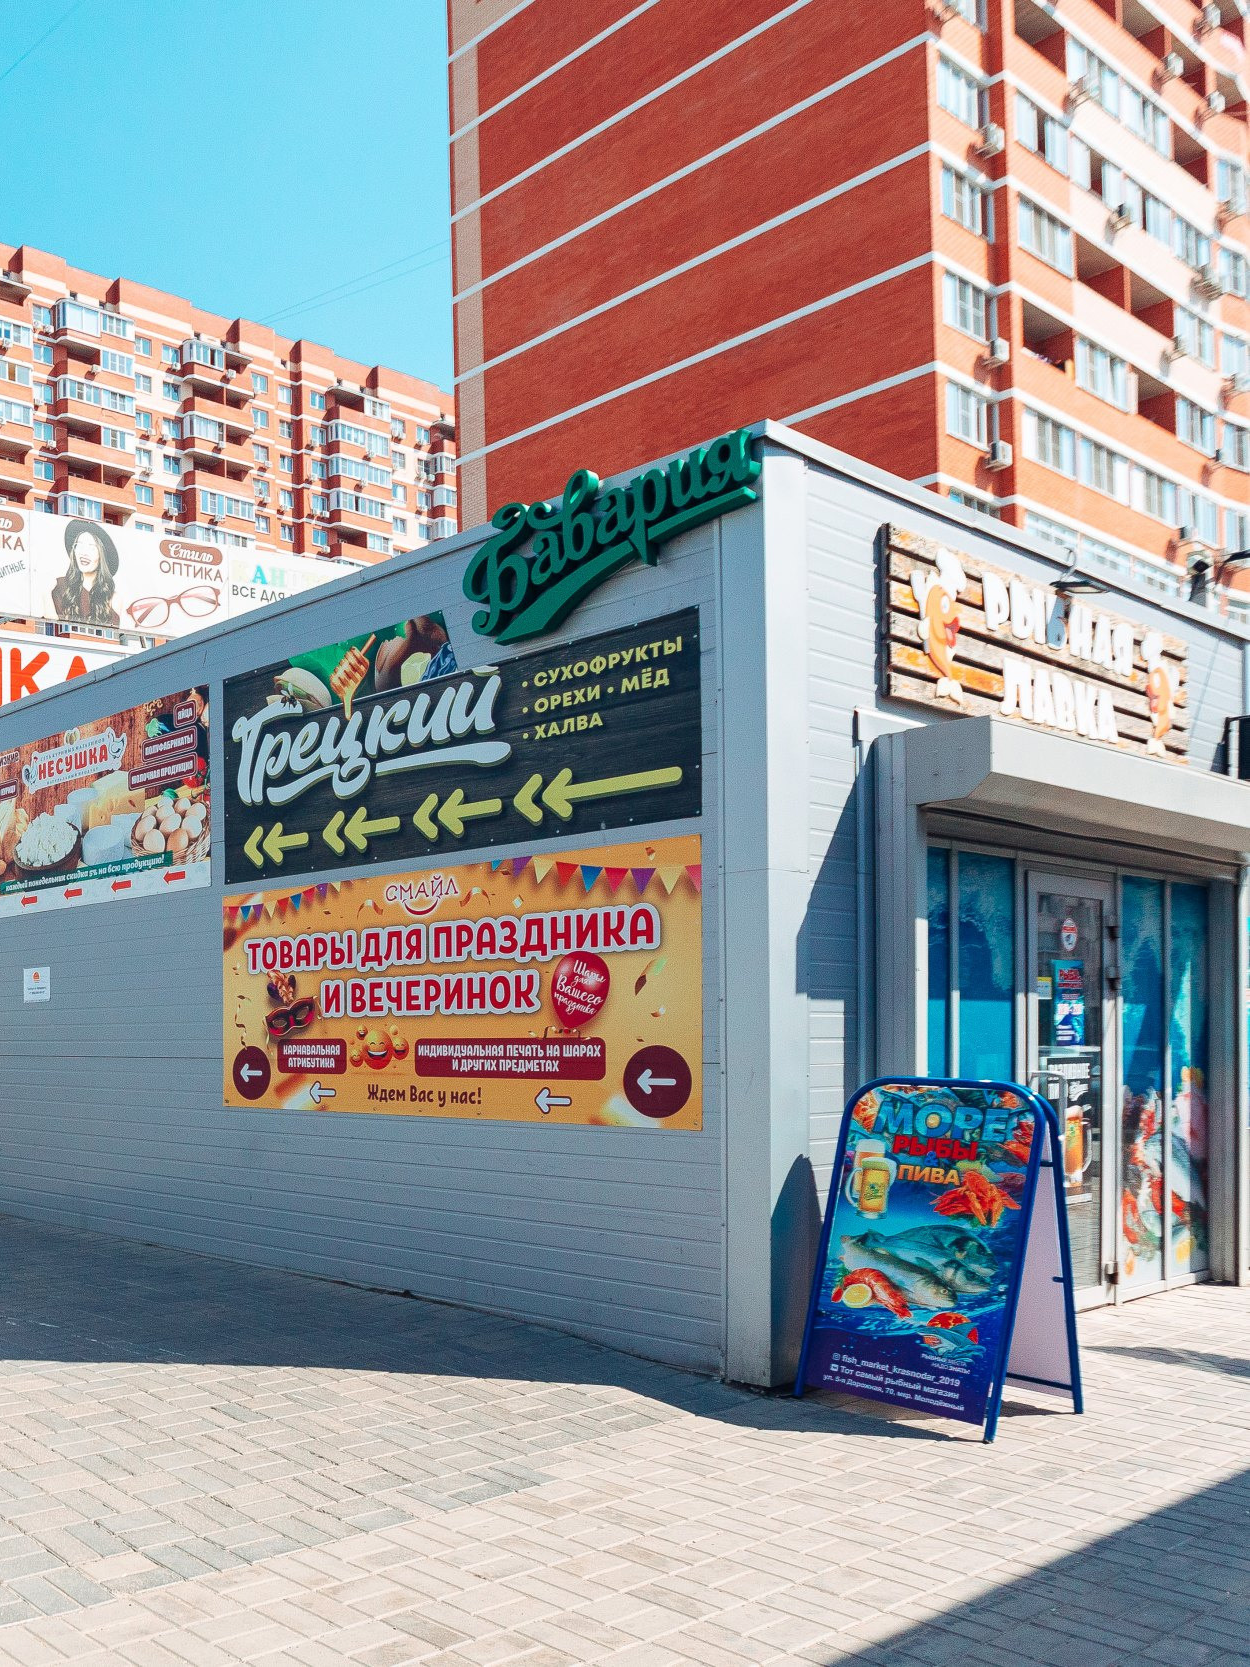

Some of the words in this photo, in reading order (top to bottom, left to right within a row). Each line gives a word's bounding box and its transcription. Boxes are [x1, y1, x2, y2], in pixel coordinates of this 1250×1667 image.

[462, 429, 761, 637] Бавария
[168, 543, 214, 563] Стиль
[159, 560, 223, 583] ОПТИКА
[232, 584, 256, 599] ВСЕ
[260, 589, 285, 603] ДЛЯ
[981, 571, 1135, 677] РЫБНАЯ
[533, 636, 684, 689] СУХОФРУКТЫ
[533, 687, 601, 715] ОРЕХИ
[620, 666, 670, 694] МЁД
[1001, 655, 1119, 743] ЛАВКА
[177, 707, 193, 721] ЯЙЦА
[534, 711, 603, 741] ХАЛВА
[145, 734, 194, 755] ПОЛУФАБРИКАТЫ
[232, 664, 506, 805] Грецкий
[38, 744, 109, 780] НЕСУШКА
[29, 873, 66, 887] понедельник
[66, 868, 89, 881] скидка
[98, 867, 107, 876] на
[107, 861, 121, 873] всю
[121, 853, 165, 873] продукцию!
[384, 873, 459, 905] СМАЙЛ
[247, 934, 353, 972] ТОВАРЫ
[361, 927, 422, 967] ДЛЯ
[434, 908, 652, 959] ПРАЗДНИКА
[574, 960, 606, 982] Шары
[325, 980, 346, 1013] И
[351, 973, 537, 1012] ВЕЧЕРИНОК
[554, 991, 597, 1015] праздника
[557, 974, 603, 1005] Вашего
[283, 1044, 341, 1057] КАРНАВАЛЬНАЯ
[288, 1056, 336, 1069] АТРИБУТИКА
[418, 1043, 505, 1058] ИНДИВИДУАЛЬНАЯ
[506, 1043, 544, 1058] ПЕЧАТЬ
[546, 1044, 561, 1057] НА
[562, 1044, 601, 1058] ШАРАХ
[452, 1059, 459, 1071] И
[459, 1059, 497, 1073] ДРУГИХ
[499, 1059, 560, 1073] ПРЕДМЕТАХ
[367, 1083, 406, 1103] Ждем
[409, 1085, 434, 1103] Вас
[438, 1090, 447, 1107] у
[451, 1087, 482, 1105] нас!
[872, 1101, 1010, 1142] МОРЕ
[892, 1135, 978, 1160] РЫБЫ
[924, 1151, 938, 1166] &
[897, 1164, 961, 1186] ПИВА
[840, 1365, 854, 1375] Тот
[855, 1370, 884, 1382] самый
[884, 1377, 922, 1391] рыбный
[923, 1385, 960, 1400] магазин
[842, 1354, 961, 1387] fish_market_krasnodar_2019
[835, 1375, 846, 1383] 5-я
[885, 1387, 896, 1396] 70,
